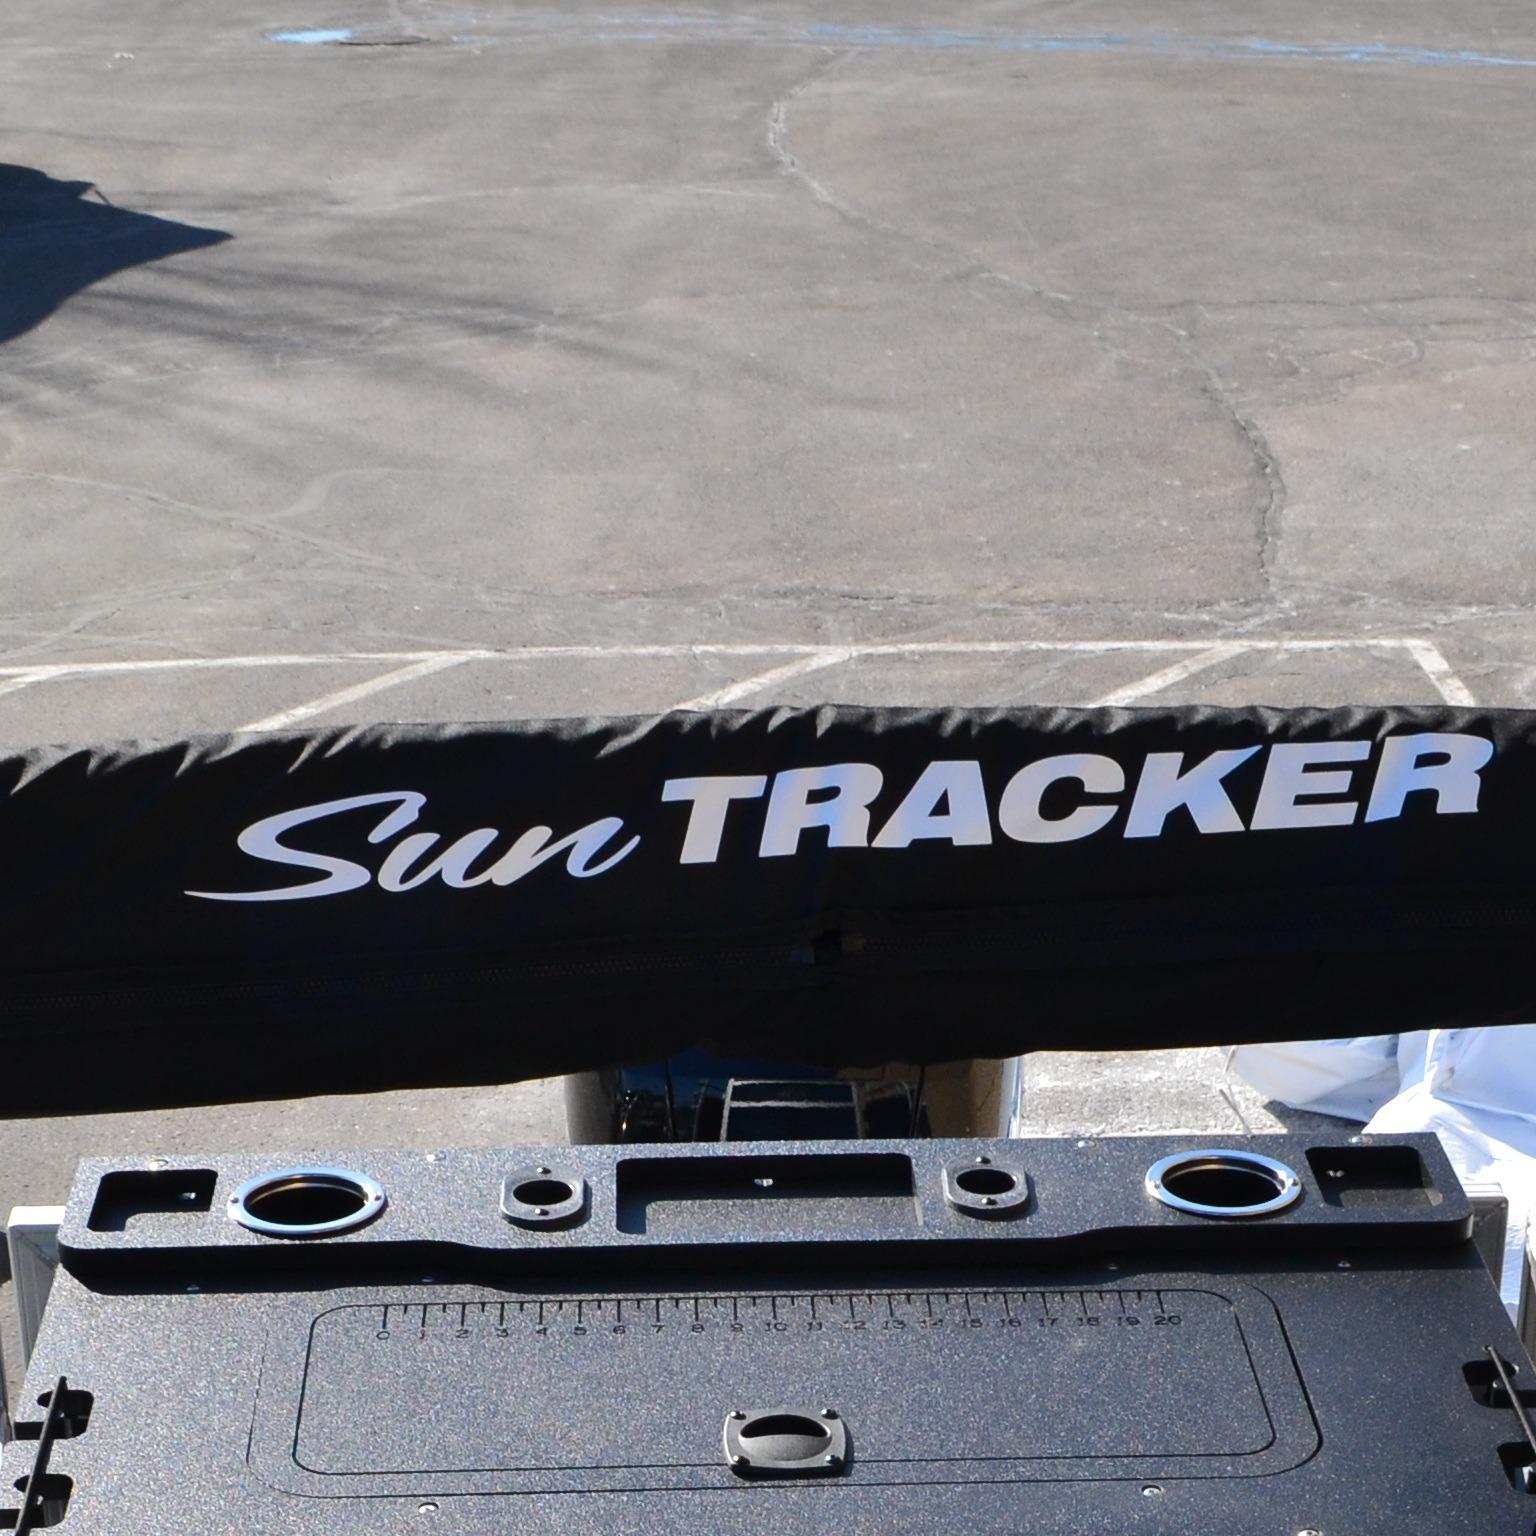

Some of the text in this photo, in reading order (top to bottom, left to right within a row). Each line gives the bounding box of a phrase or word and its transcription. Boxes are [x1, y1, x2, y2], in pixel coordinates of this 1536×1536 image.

[184, 732, 1494, 902] Sun TRACKER
[375, 1330, 391, 1341] 0
[417, 1327, 426, 1340] 1
[455, 1328, 470, 1339] 2
[495, 1327, 510, 1338] 3
[535, 1326, 549, 1336] 4
[573, 1326, 587, 1336] 5
[611, 1325, 627, 1335] 6
[651, 1324, 664, 1334] 7
[690, 1323, 706, 1334] 8
[729, 1322, 745, 1333] 9
[763, 1321, 788, 1333] 10
[806, 1321, 823, 1332] 11
[882, 1319, 906, 1331] 13
[1000, 1317, 1022, 1329] 16
[1039, 1316, 1059, 1328] 17
[1076, 1315, 1100, 1327] 18
[1117, 1315, 1141, 1327] 19
[1153, 1314, 1183, 1326] 20
